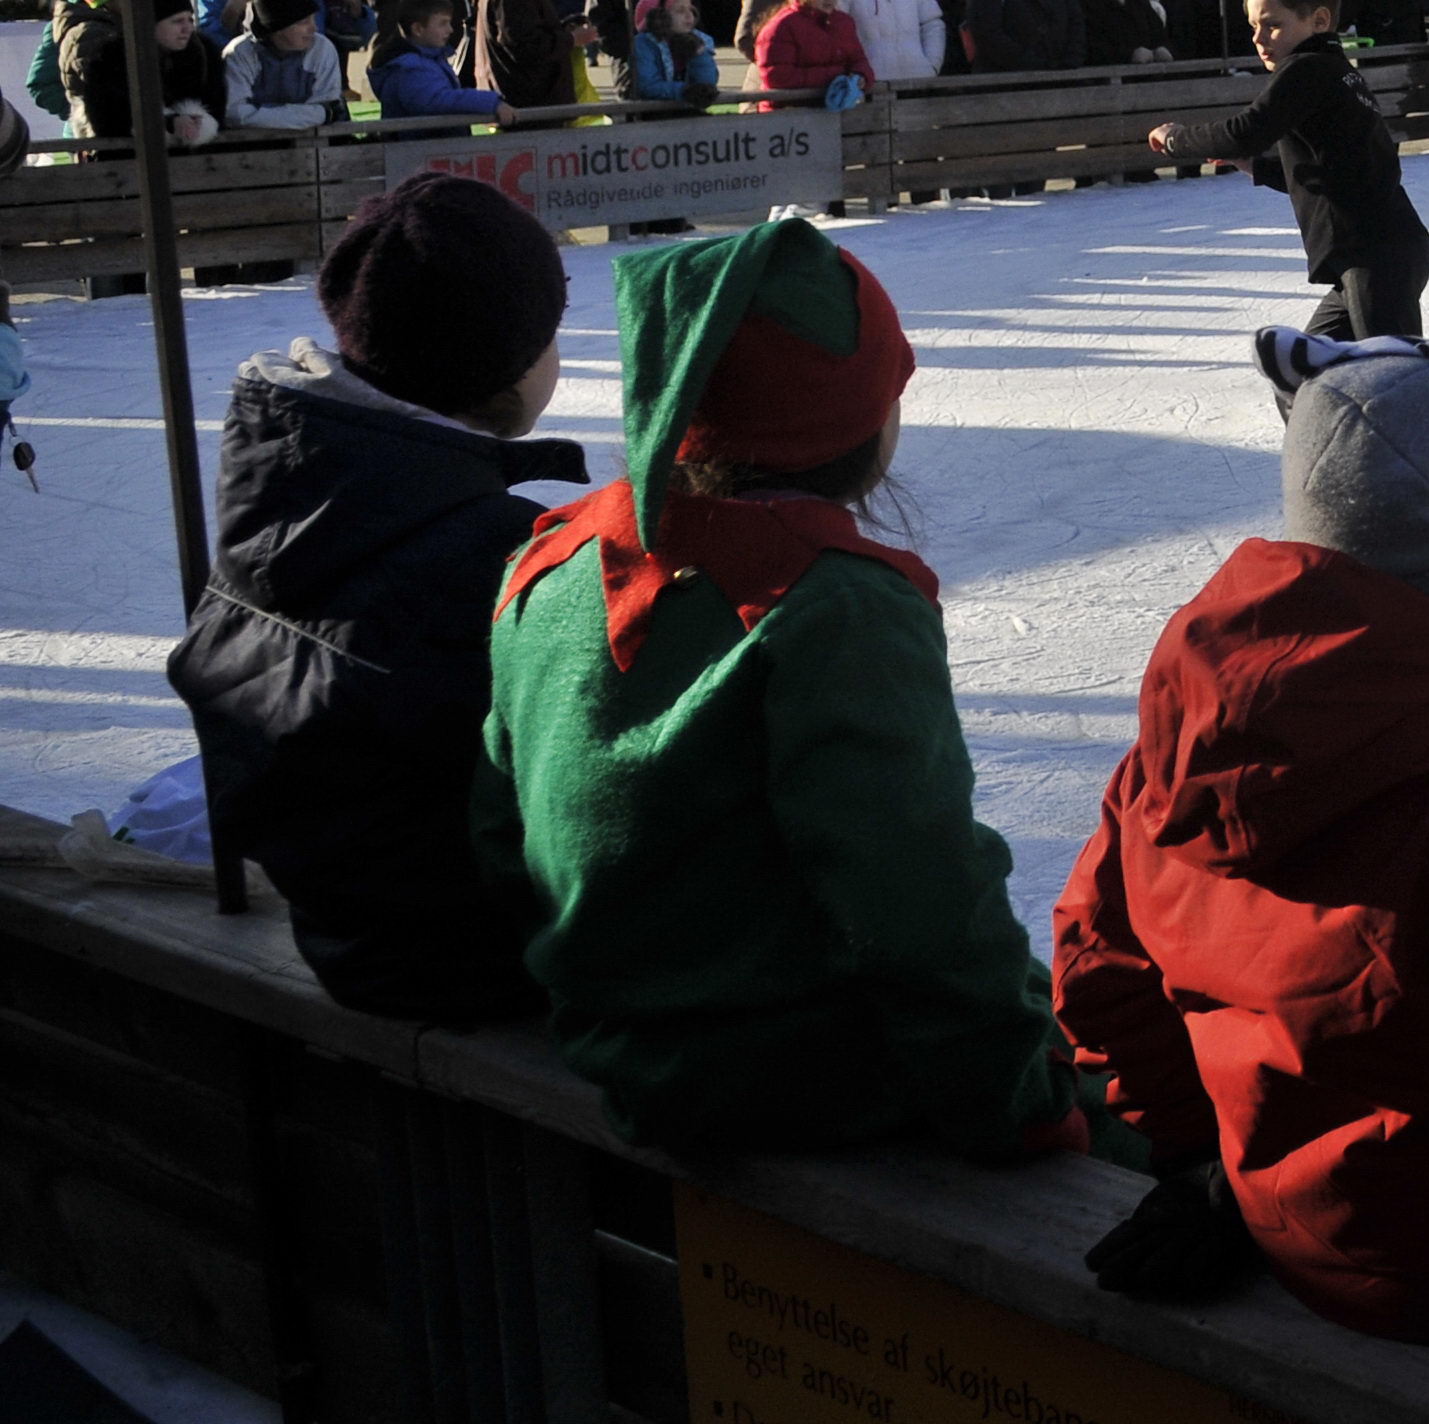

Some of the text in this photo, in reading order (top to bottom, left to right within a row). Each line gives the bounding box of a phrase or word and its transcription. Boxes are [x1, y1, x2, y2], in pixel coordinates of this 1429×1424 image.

[546, 127, 810, 178] midtconsult a/s
[547, 173, 769, 210] Rådgivende ingeniører
[722, 1260, 1098, 1424] Benyttelse af skøjteban
[727, 1330, 790, 1380] eget
[802, 1361, 896, 1424] ansvar
